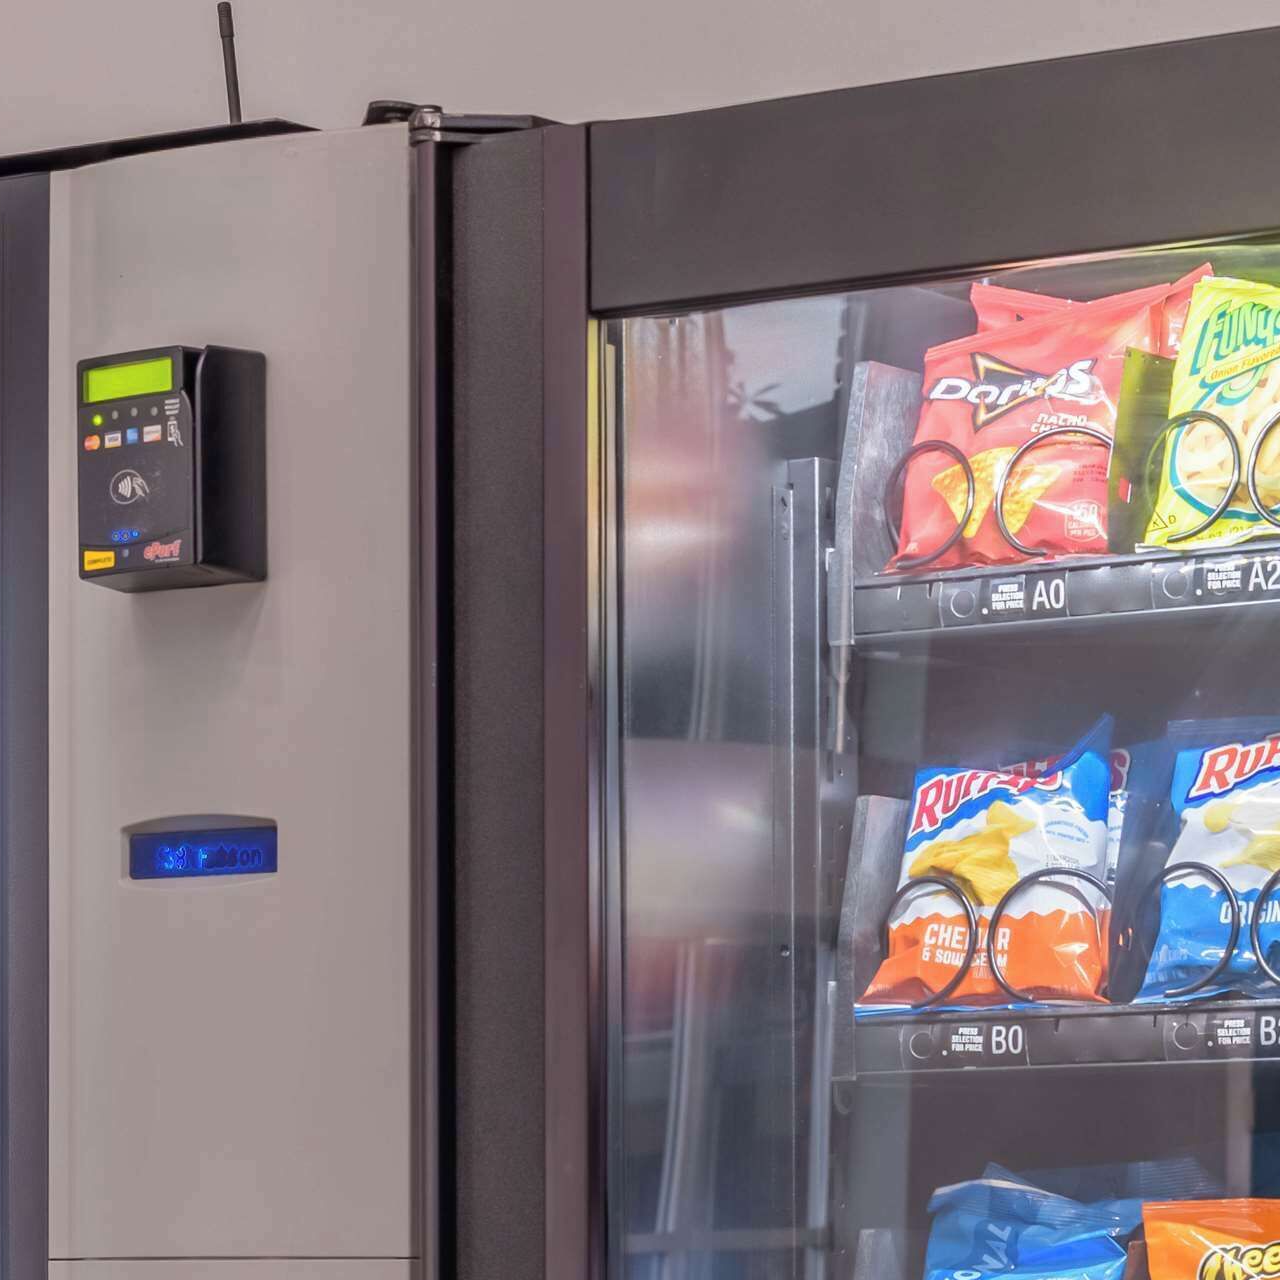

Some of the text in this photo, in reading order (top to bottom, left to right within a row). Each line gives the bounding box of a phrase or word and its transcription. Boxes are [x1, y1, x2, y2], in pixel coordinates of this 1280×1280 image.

[928, 358, 1097, 407] Doritos
[1033, 578, 1065, 609] A0
[991, 1026, 1022, 1054] B0
